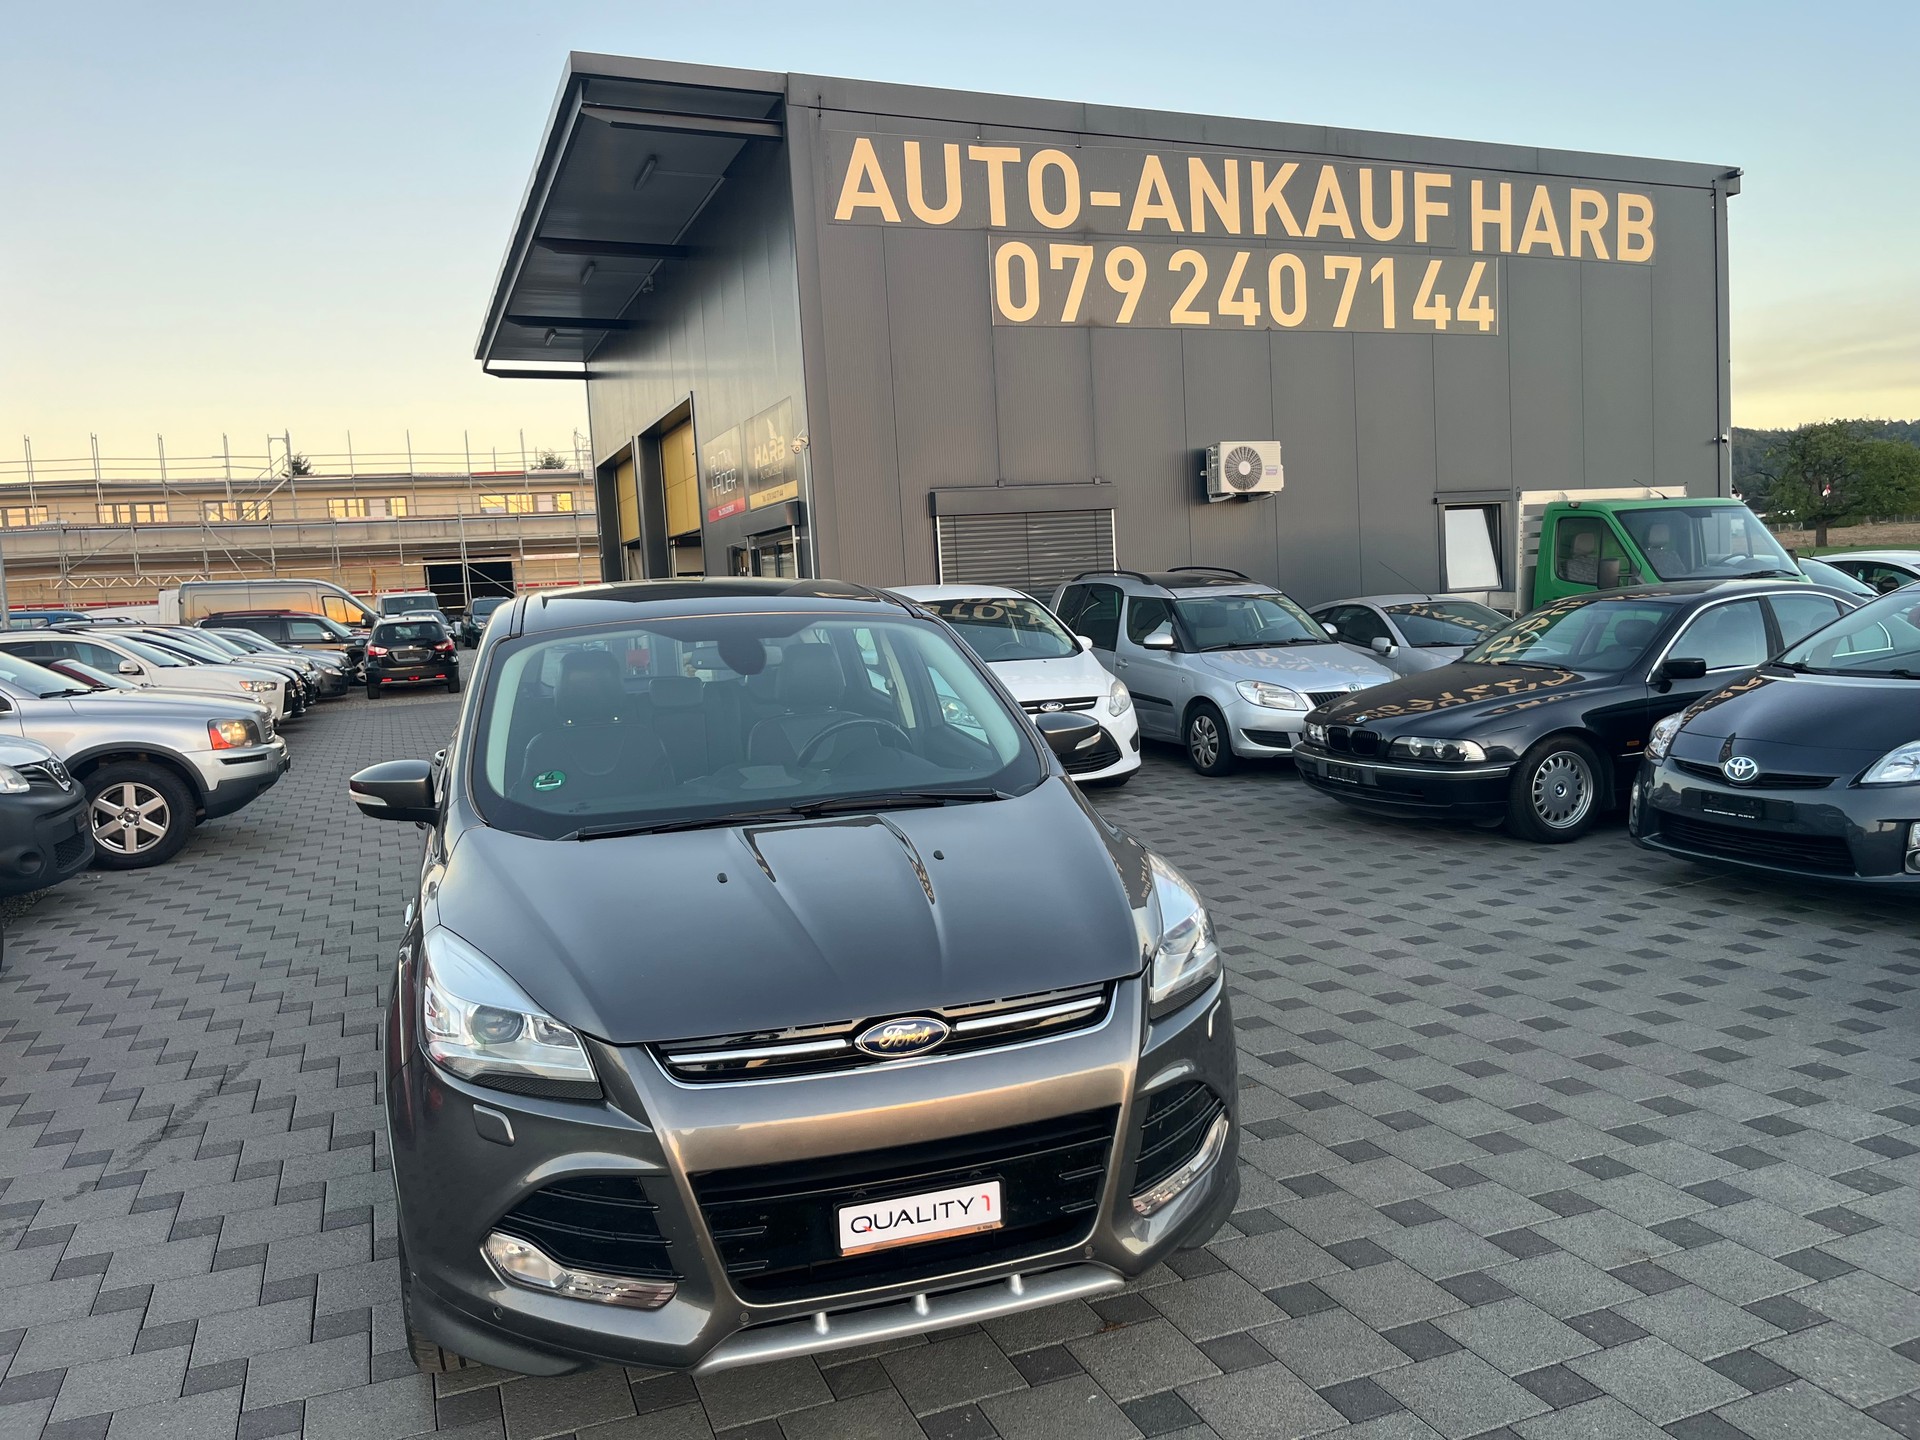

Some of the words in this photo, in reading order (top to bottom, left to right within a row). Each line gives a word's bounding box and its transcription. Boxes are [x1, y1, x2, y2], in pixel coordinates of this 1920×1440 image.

[835, 137, 1452, 243] AUTO-ANKAUF
[1471, 179, 1655, 262] HARB
[995, 241, 1148, 325] 079
[1168, 249, 1308, 328] 240
[754, 435, 786, 470] HARB
[878, 1022, 931, 1049] Ford
[850, 1196, 975, 1234] QUALITY
[981, 1194, 991, 1212] 1
